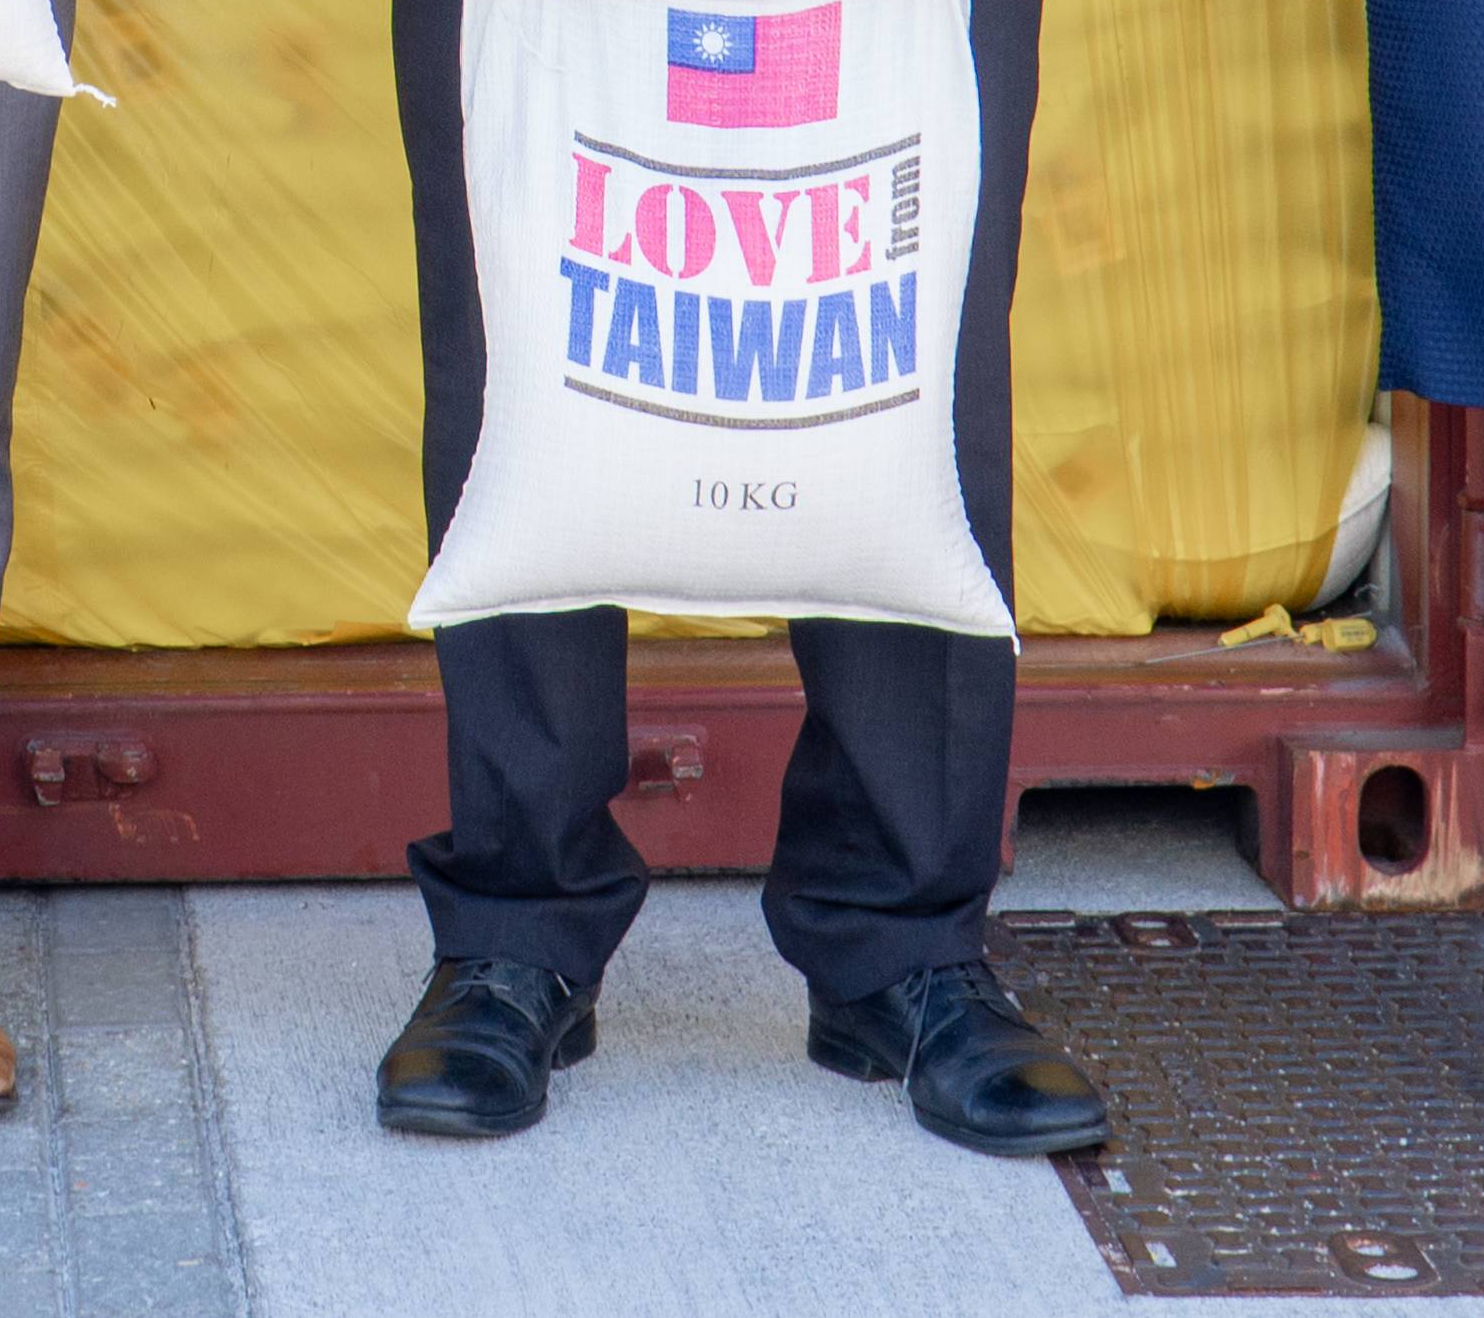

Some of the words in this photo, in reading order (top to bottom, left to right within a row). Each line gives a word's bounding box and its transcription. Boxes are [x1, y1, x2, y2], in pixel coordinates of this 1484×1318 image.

[569, 152, 872, 287] LOVE
[885, 155, 922, 261] from
[560, 255, 917, 402] TAIWAN
[693, 477, 729, 511] 10
[739, 481, 799, 511] KG
